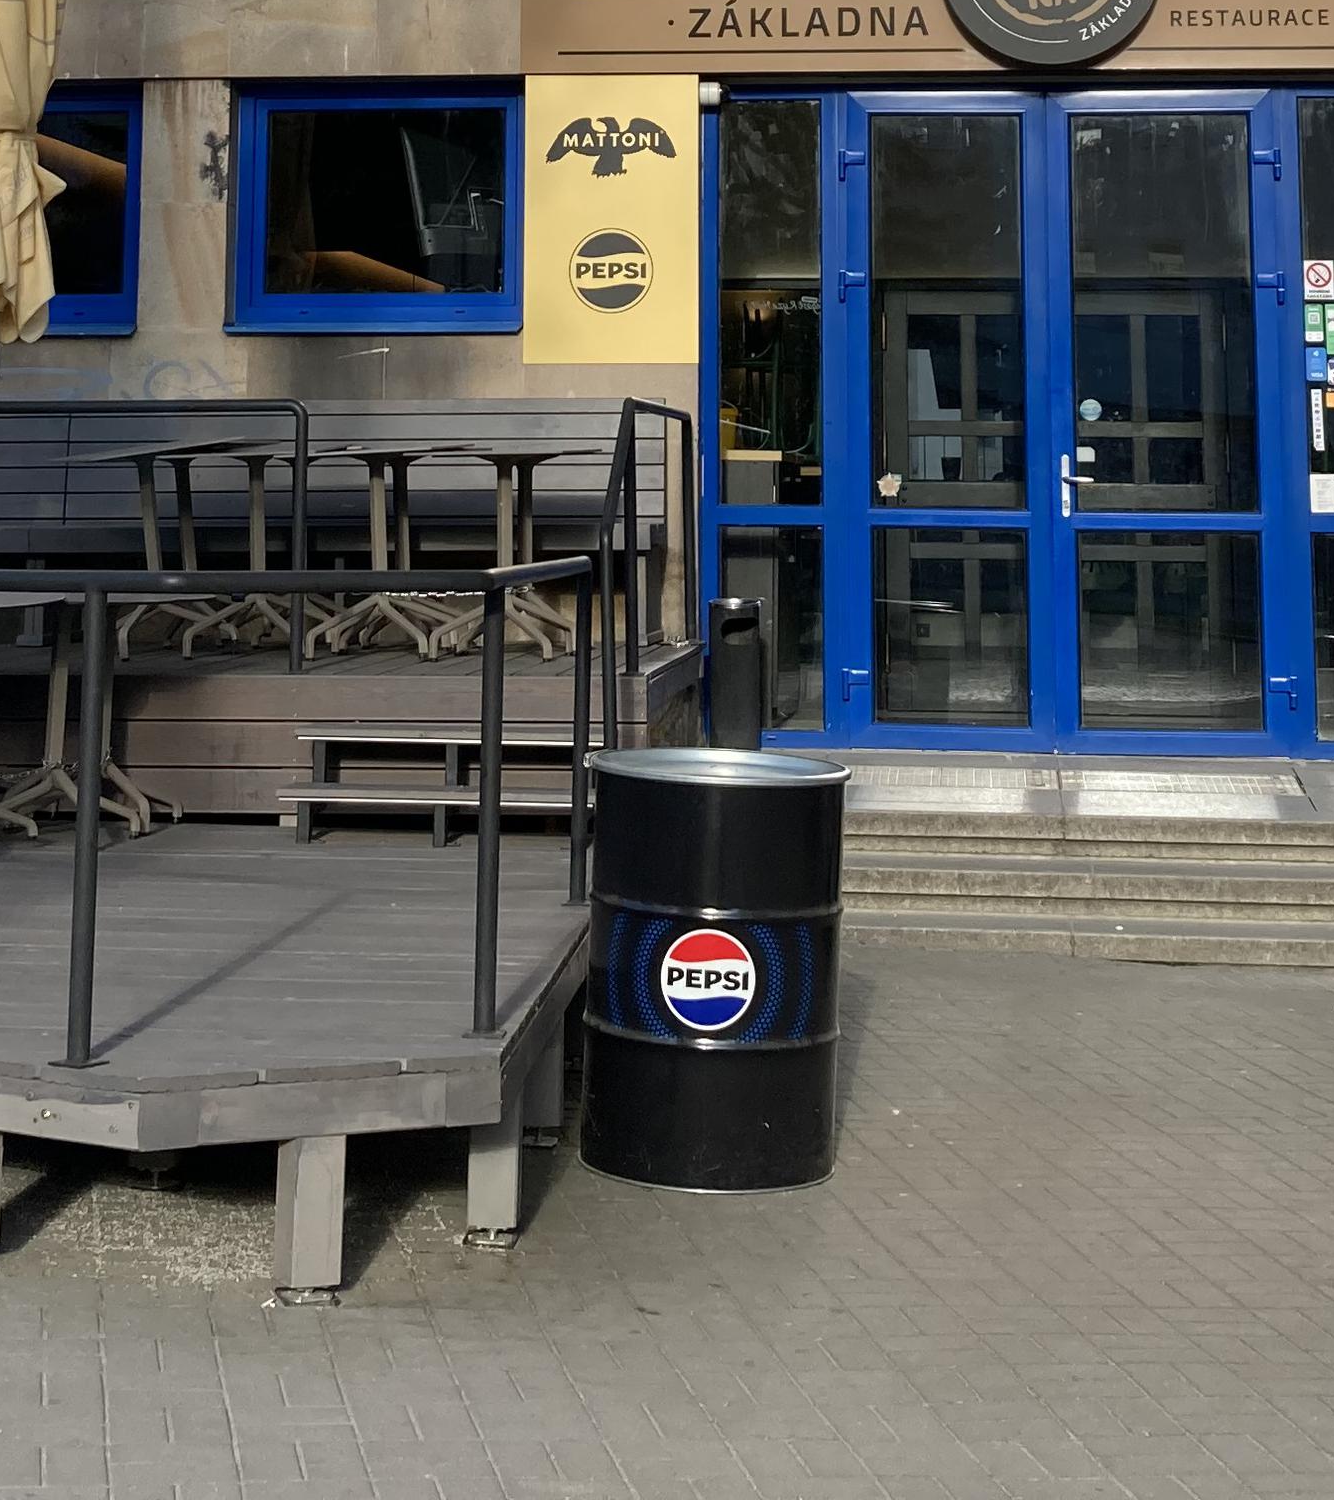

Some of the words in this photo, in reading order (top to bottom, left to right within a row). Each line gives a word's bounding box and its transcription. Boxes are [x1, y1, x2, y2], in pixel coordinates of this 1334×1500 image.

[1170, 8, 1330, 27] RESTAURACE
[562, 131, 660, 149] MATTONI
[575, 261, 647, 280] PEPSI
[666, 966, 749, 991] PEPSI
